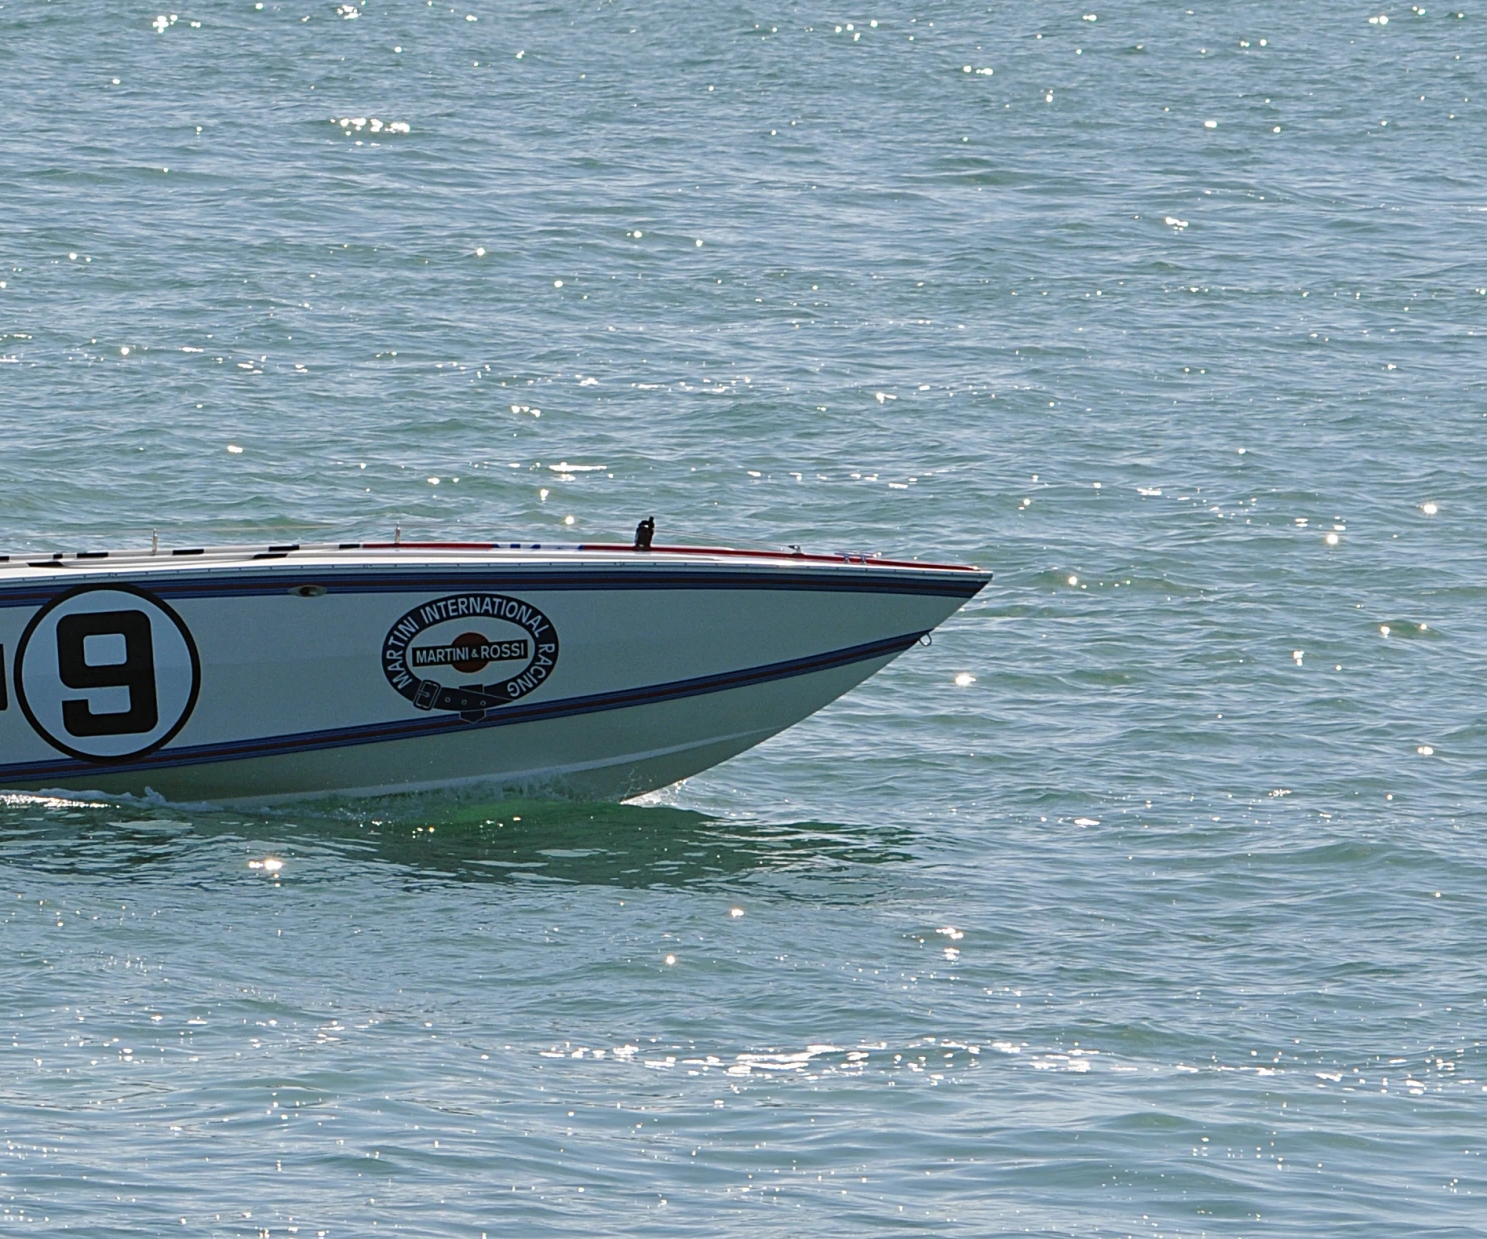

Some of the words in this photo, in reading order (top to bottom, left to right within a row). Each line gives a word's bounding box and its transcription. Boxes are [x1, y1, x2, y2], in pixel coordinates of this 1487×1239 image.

[56, 609, 159, 737] 9
[386, 616, 419, 689] MARTINI
[420, 596, 550, 639] INTERNATIONAL
[507, 642, 556, 697] RACING
[415, 645, 470, 664] MARTINI
[471, 649, 480, 659] &
[480, 642, 526, 660] ROSSI
